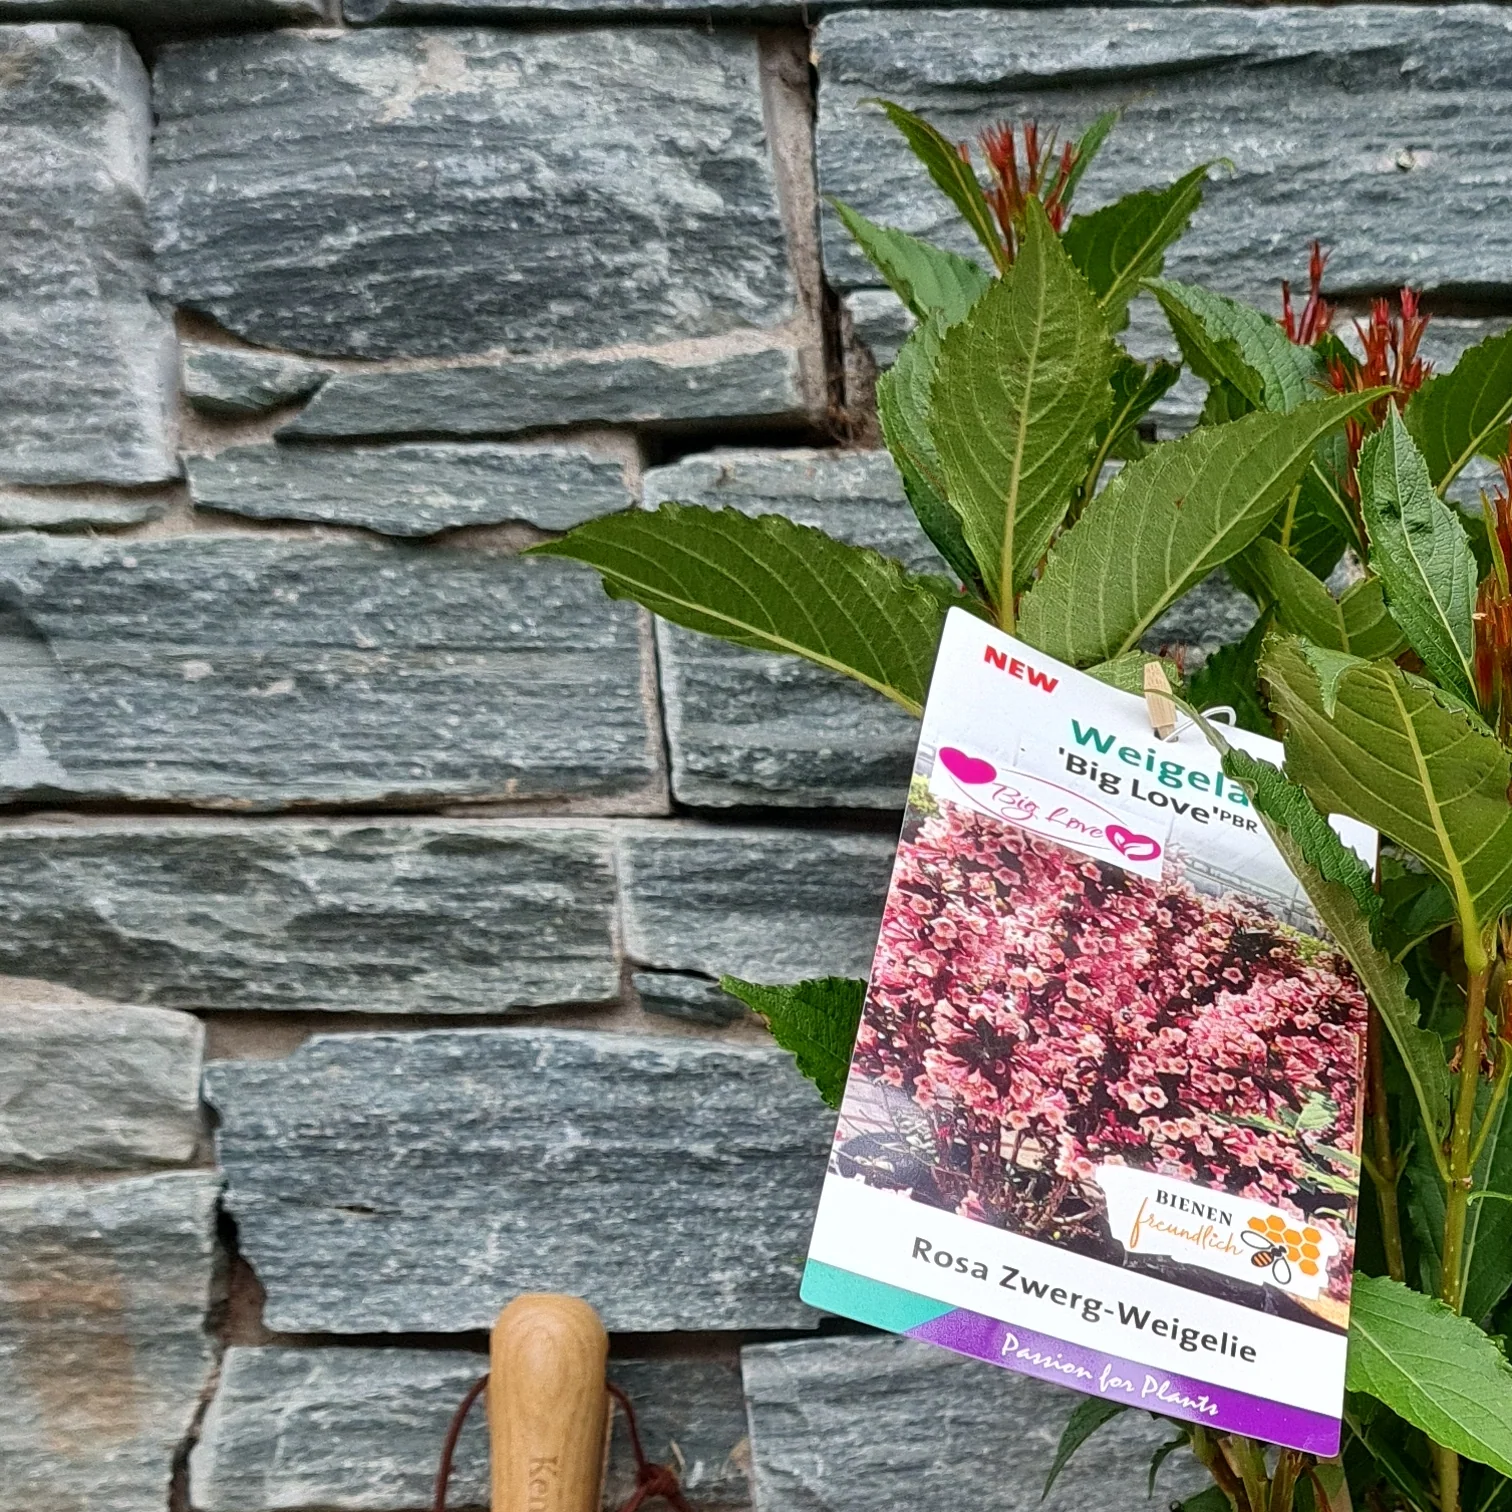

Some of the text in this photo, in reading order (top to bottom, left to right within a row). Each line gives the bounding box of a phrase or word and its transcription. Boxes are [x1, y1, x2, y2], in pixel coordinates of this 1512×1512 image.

[984, 645, 1060, 694] NEW
[1058, 746, 1121, 796] 'Big
[1071, 718, 1251, 808] Weigela
[989, 782, 1105, 840] Big Love
[1129, 1197, 1247, 1257] freundlich
[1155, 1188, 1234, 1228] BIENEN
[911, 1236, 1258, 1364] Rosa Zwerg-Weigelie
[1000, 1331, 1220, 1417] Passion for Plants
